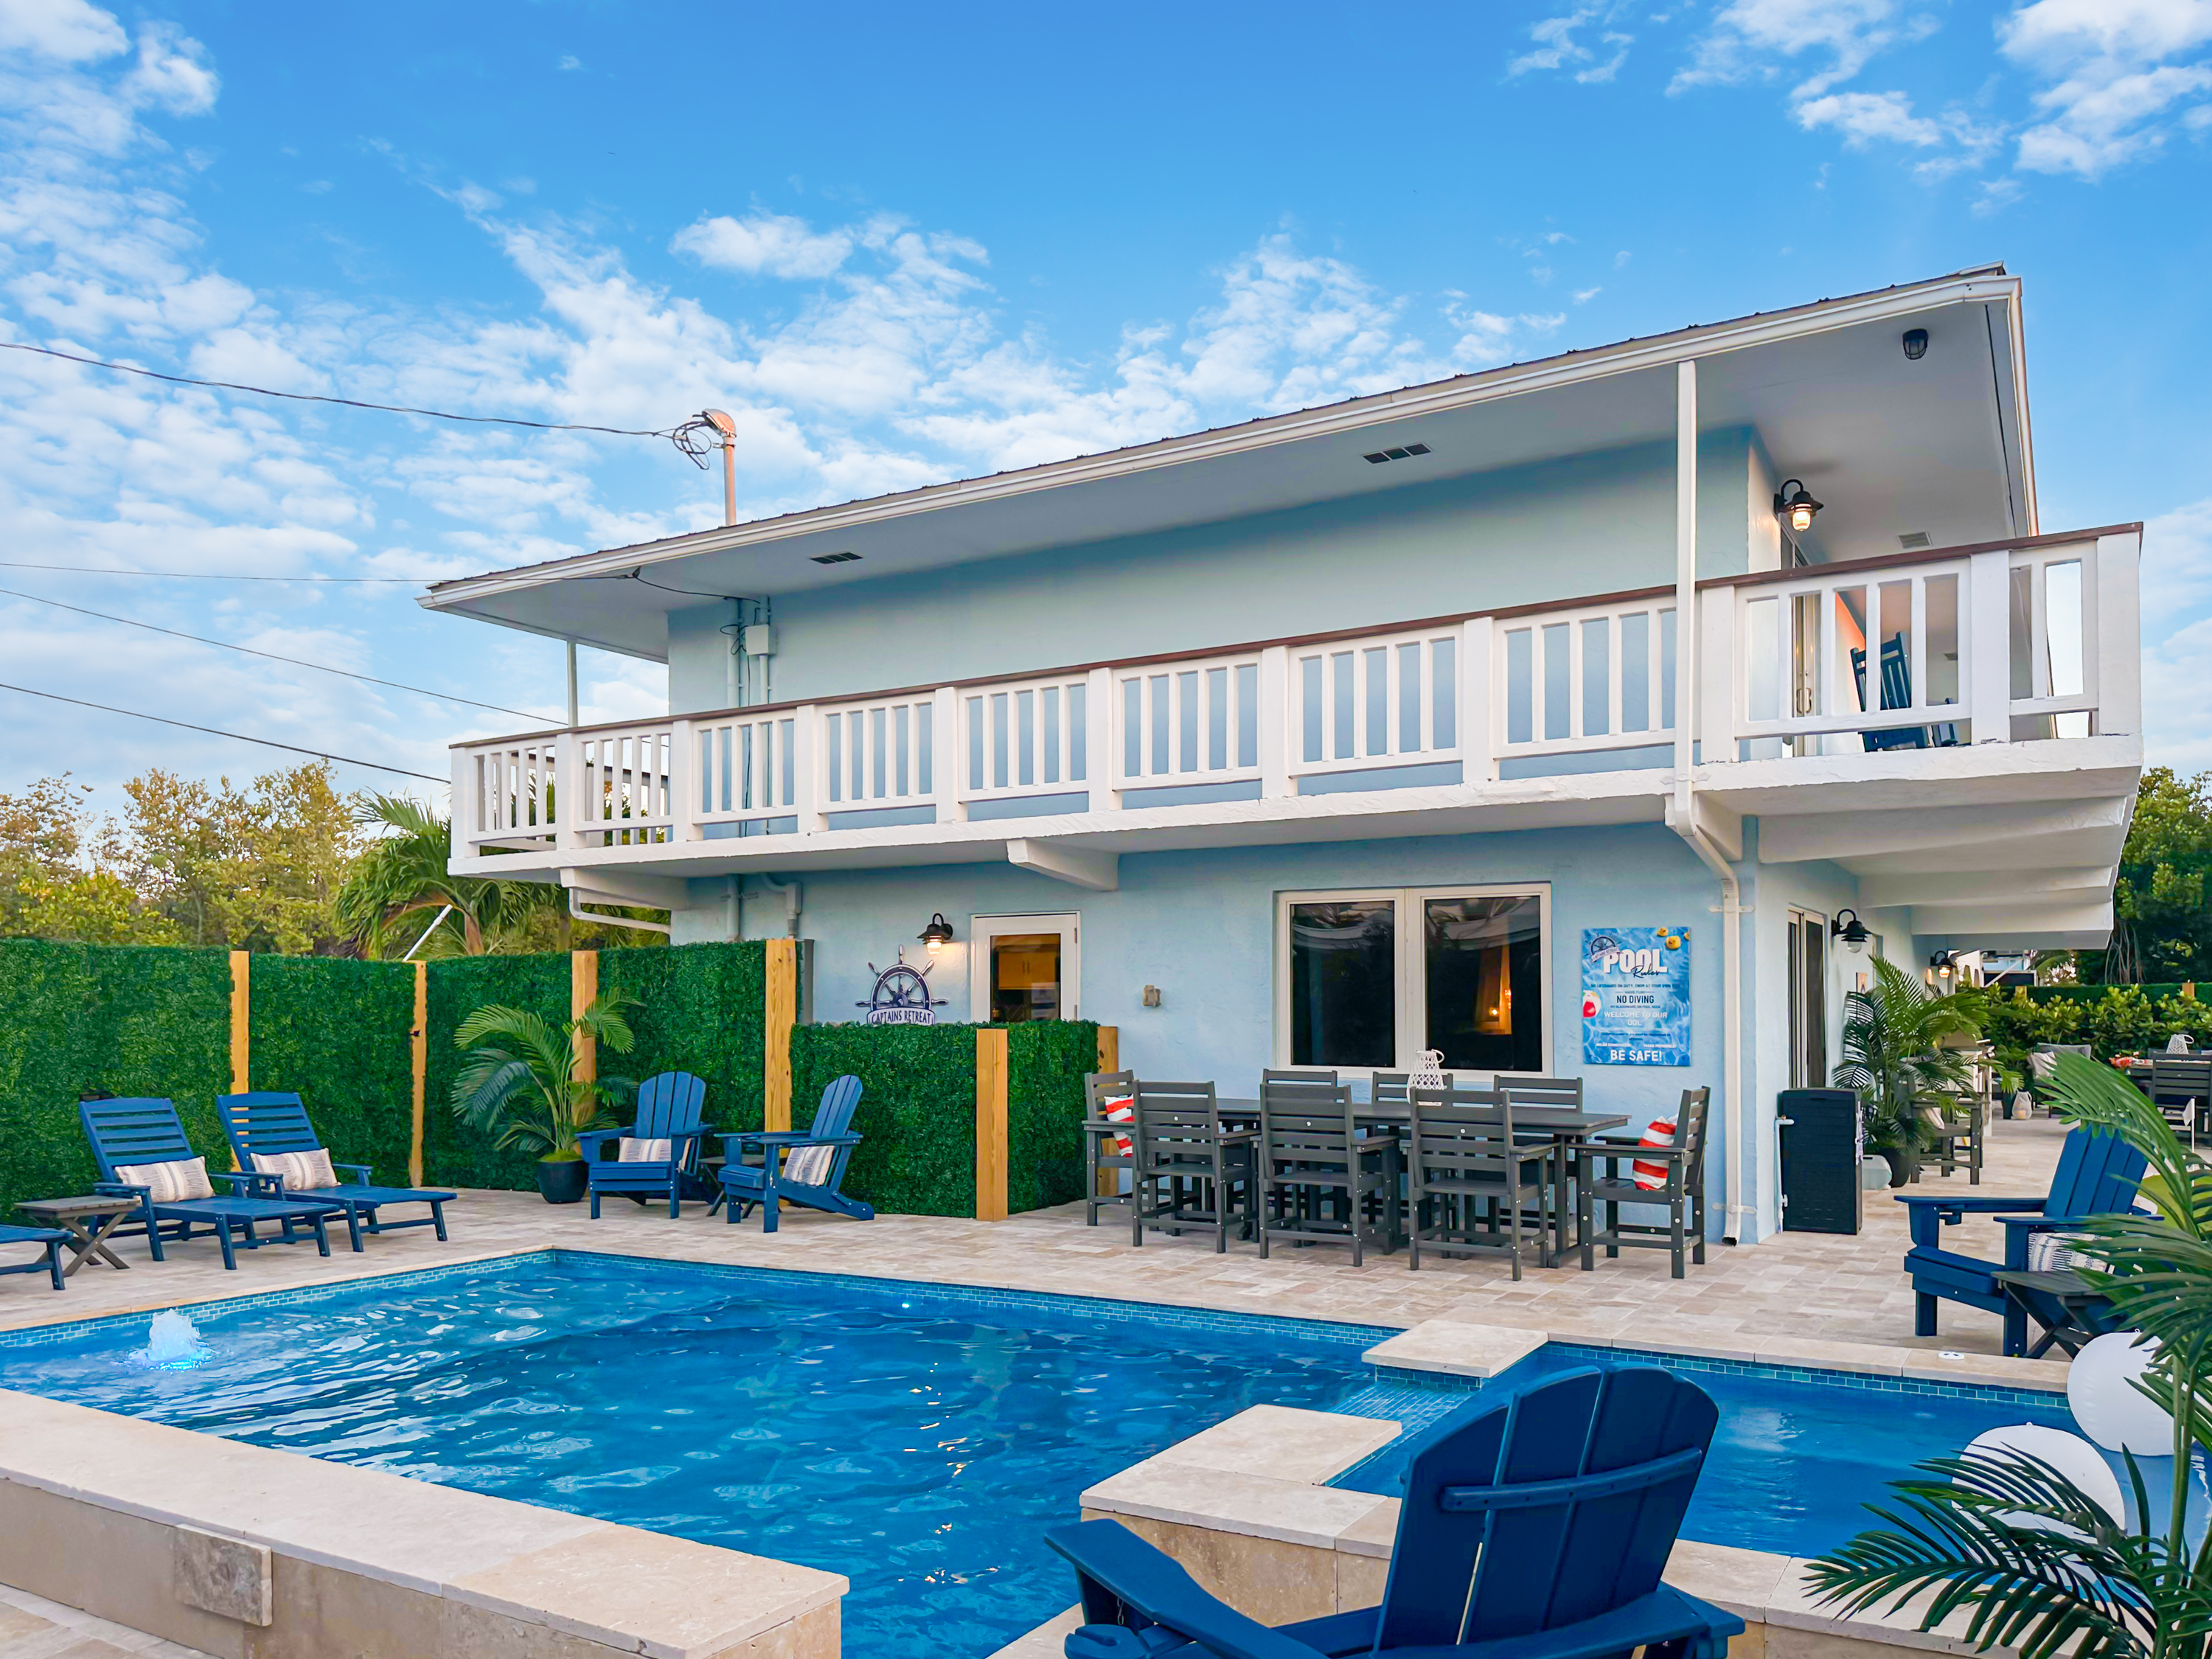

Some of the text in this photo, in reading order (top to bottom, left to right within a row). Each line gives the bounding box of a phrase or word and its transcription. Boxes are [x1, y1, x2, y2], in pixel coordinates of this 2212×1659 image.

[1603, 948, 1668, 973] POOL
[1631, 964, 1660, 978] Rules
[1616, 995, 1655, 1004] NO DIVING
[872, 1010, 931, 1024] CAPTAINS RETREAT
[1610, 1049, 1663, 1062] BE SAFE!
